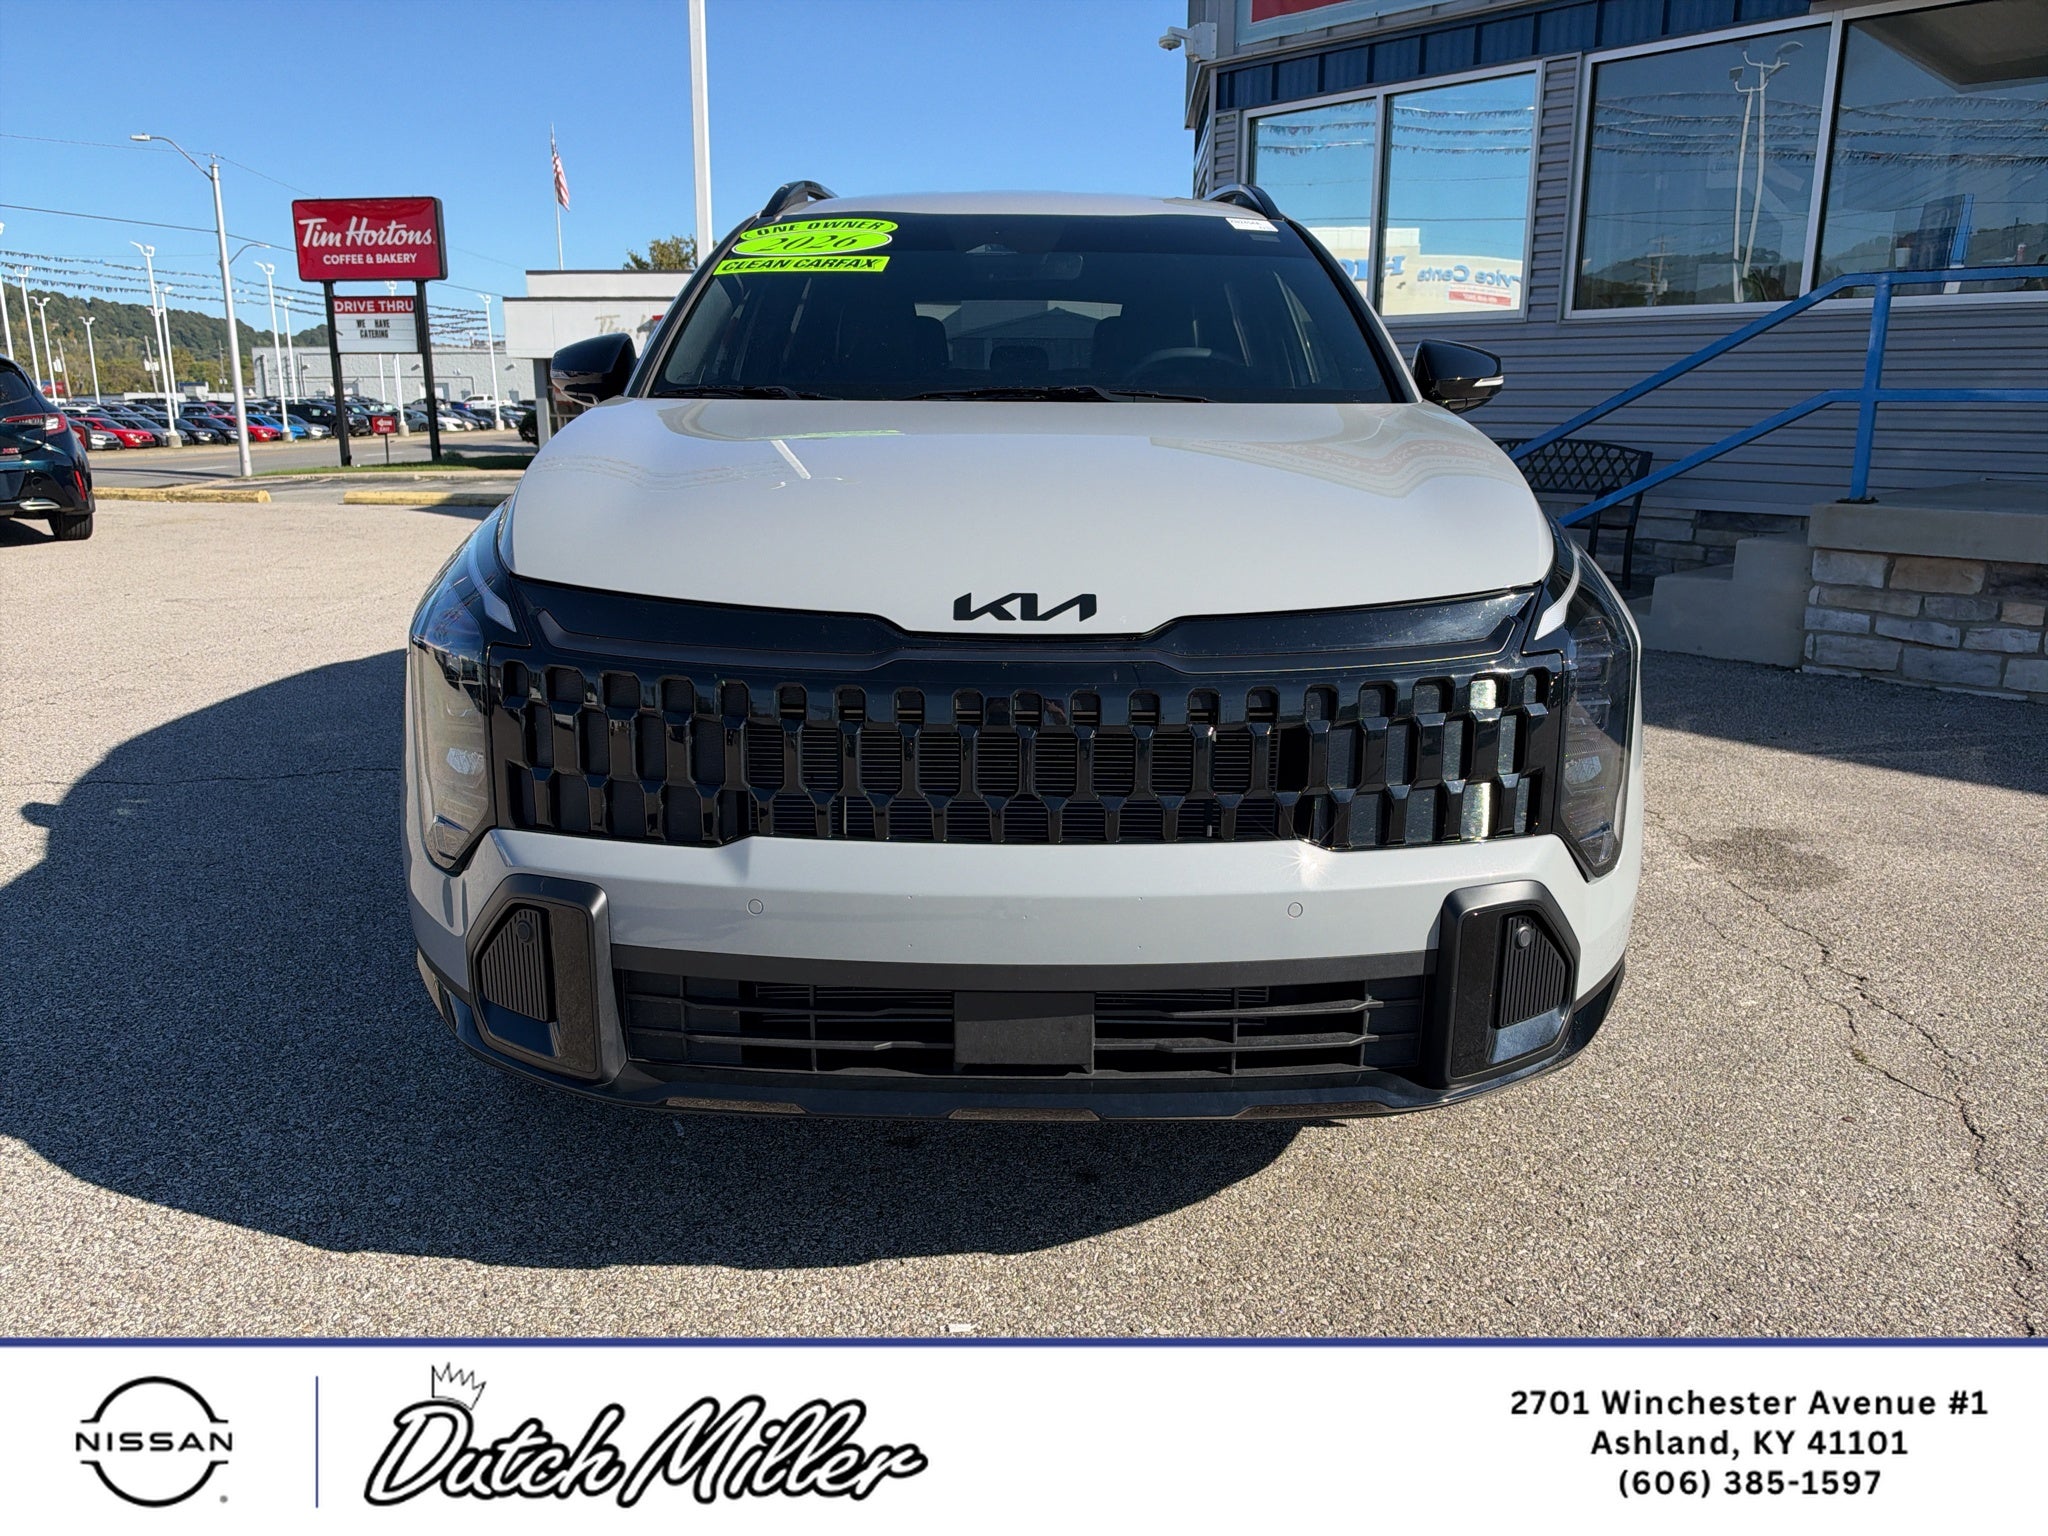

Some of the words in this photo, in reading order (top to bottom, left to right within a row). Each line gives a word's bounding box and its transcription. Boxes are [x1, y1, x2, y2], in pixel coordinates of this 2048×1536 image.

[299, 218, 342, 248] Tim
[346, 216, 433, 247] Hortons
[757, 225, 800, 236] ONE
[808, 221, 884, 231] OWNER
[756, 233, 867, 252] 2026
[323, 254, 364, 265] COFFEE
[366, 254, 374, 264] &
[376, 253, 417, 264] BAKERY
[722, 259, 791, 271] CLEAN
[793, 258, 879, 270] CARFAX
[334, 301, 375, 312] DRIVE
[378, 300, 414, 312] THRU
[356, 319, 365, 328] WE
[374, 319, 390, 328] HAVE
[360, 330, 389, 338] CATERING
